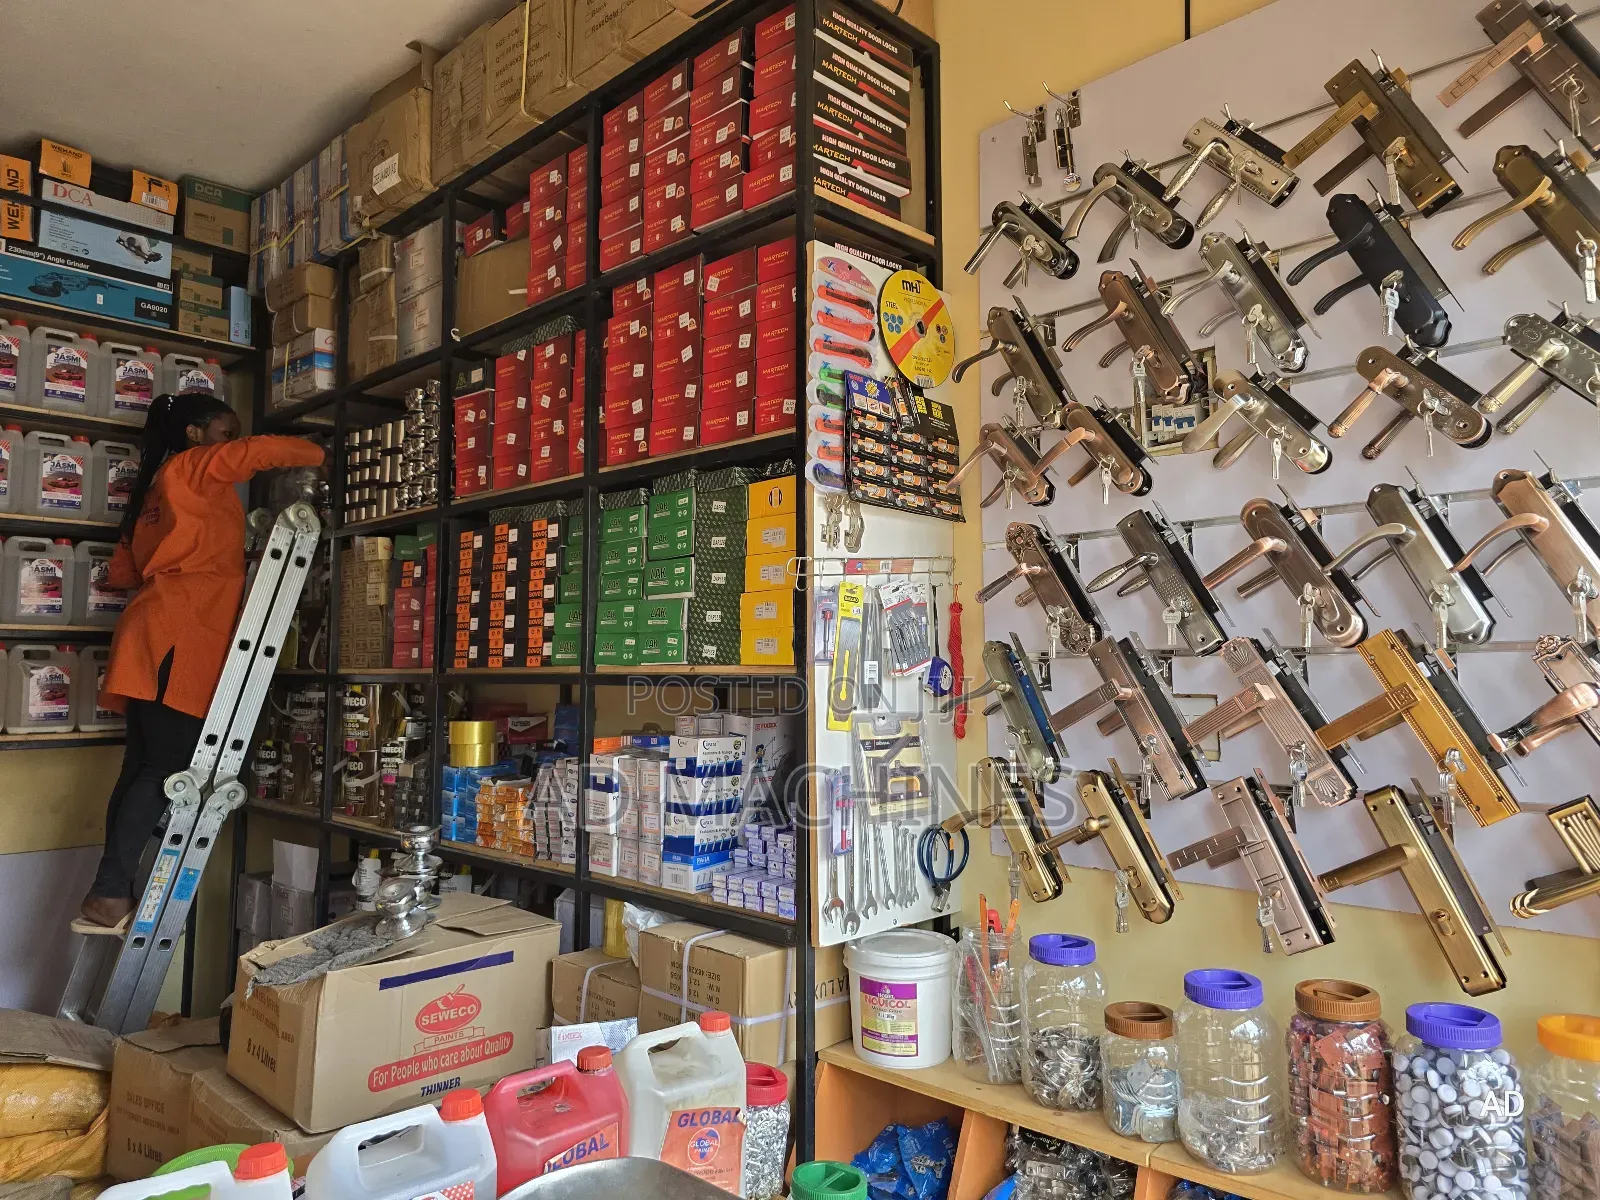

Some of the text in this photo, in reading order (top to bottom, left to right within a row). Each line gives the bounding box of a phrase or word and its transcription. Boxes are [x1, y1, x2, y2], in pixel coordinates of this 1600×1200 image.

[822, 18, 858, 43] MARTECH
[846, 18, 868, 37] QUALITY
[882, 38, 898, 54] LOCKS
[822, 60, 857, 84] MARTECH
[844, 58, 866, 79] QUALITY
[880, 79, 896, 96] LOCKS
[818, 102, 852, 123] MARTECH
[841, 98, 863, 118] QUALITY
[876, 117, 892, 134] LOCKS
[814, 144, 850, 163] MARTECH
[837, 139, 861, 158] QUALITY
[878, 155, 896, 169] LOCKS
[749, 174, 775, 188] MARTECH
[52, 183, 92, 207] DCA
[195, 182, 222, 198] DCA
[870, 189, 886, 202] LOCKS
[47, 255, 66, 265] Angle
[66, 259, 90, 270] Grinder
[763, 250, 789, 263] MARTECH
[849, 247, 871, 260] QUALITY
[886, 260, 902, 271] LOCKS
[761, 284, 785, 294] MARTECH
[140, 302, 168, 314] GA9020
[709, 305, 733, 316] MARTECH
[886, 301, 898, 309] STEEL
[763, 327, 788, 338] MARTECH
[708, 343, 732, 353] MARTECH
[763, 364, 788, 374] MARTECH
[708, 379, 732, 389] MARTECH
[421, 1004, 477, 1026] SEWECO
[281, 1031, 294, 1042] AREA
[434, 1030, 464, 1044] PAINTS
[252, 1044, 255, 1056] x
[257, 1045, 260, 1060] 4
[261, 1047, 276, 1072] Litres
[373, 1036, 511, 1087] For People who care about Quality
[421, 1077, 460, 1097] THINNER
[144, 1098, 164, 1114] OFFICE
[678, 1110, 740, 1127] GLOBAL
[690, 1140, 718, 1148] GLOBAL
[138, 1142, 142, 1155] 4
[145, 1144, 163, 1163] Litres
